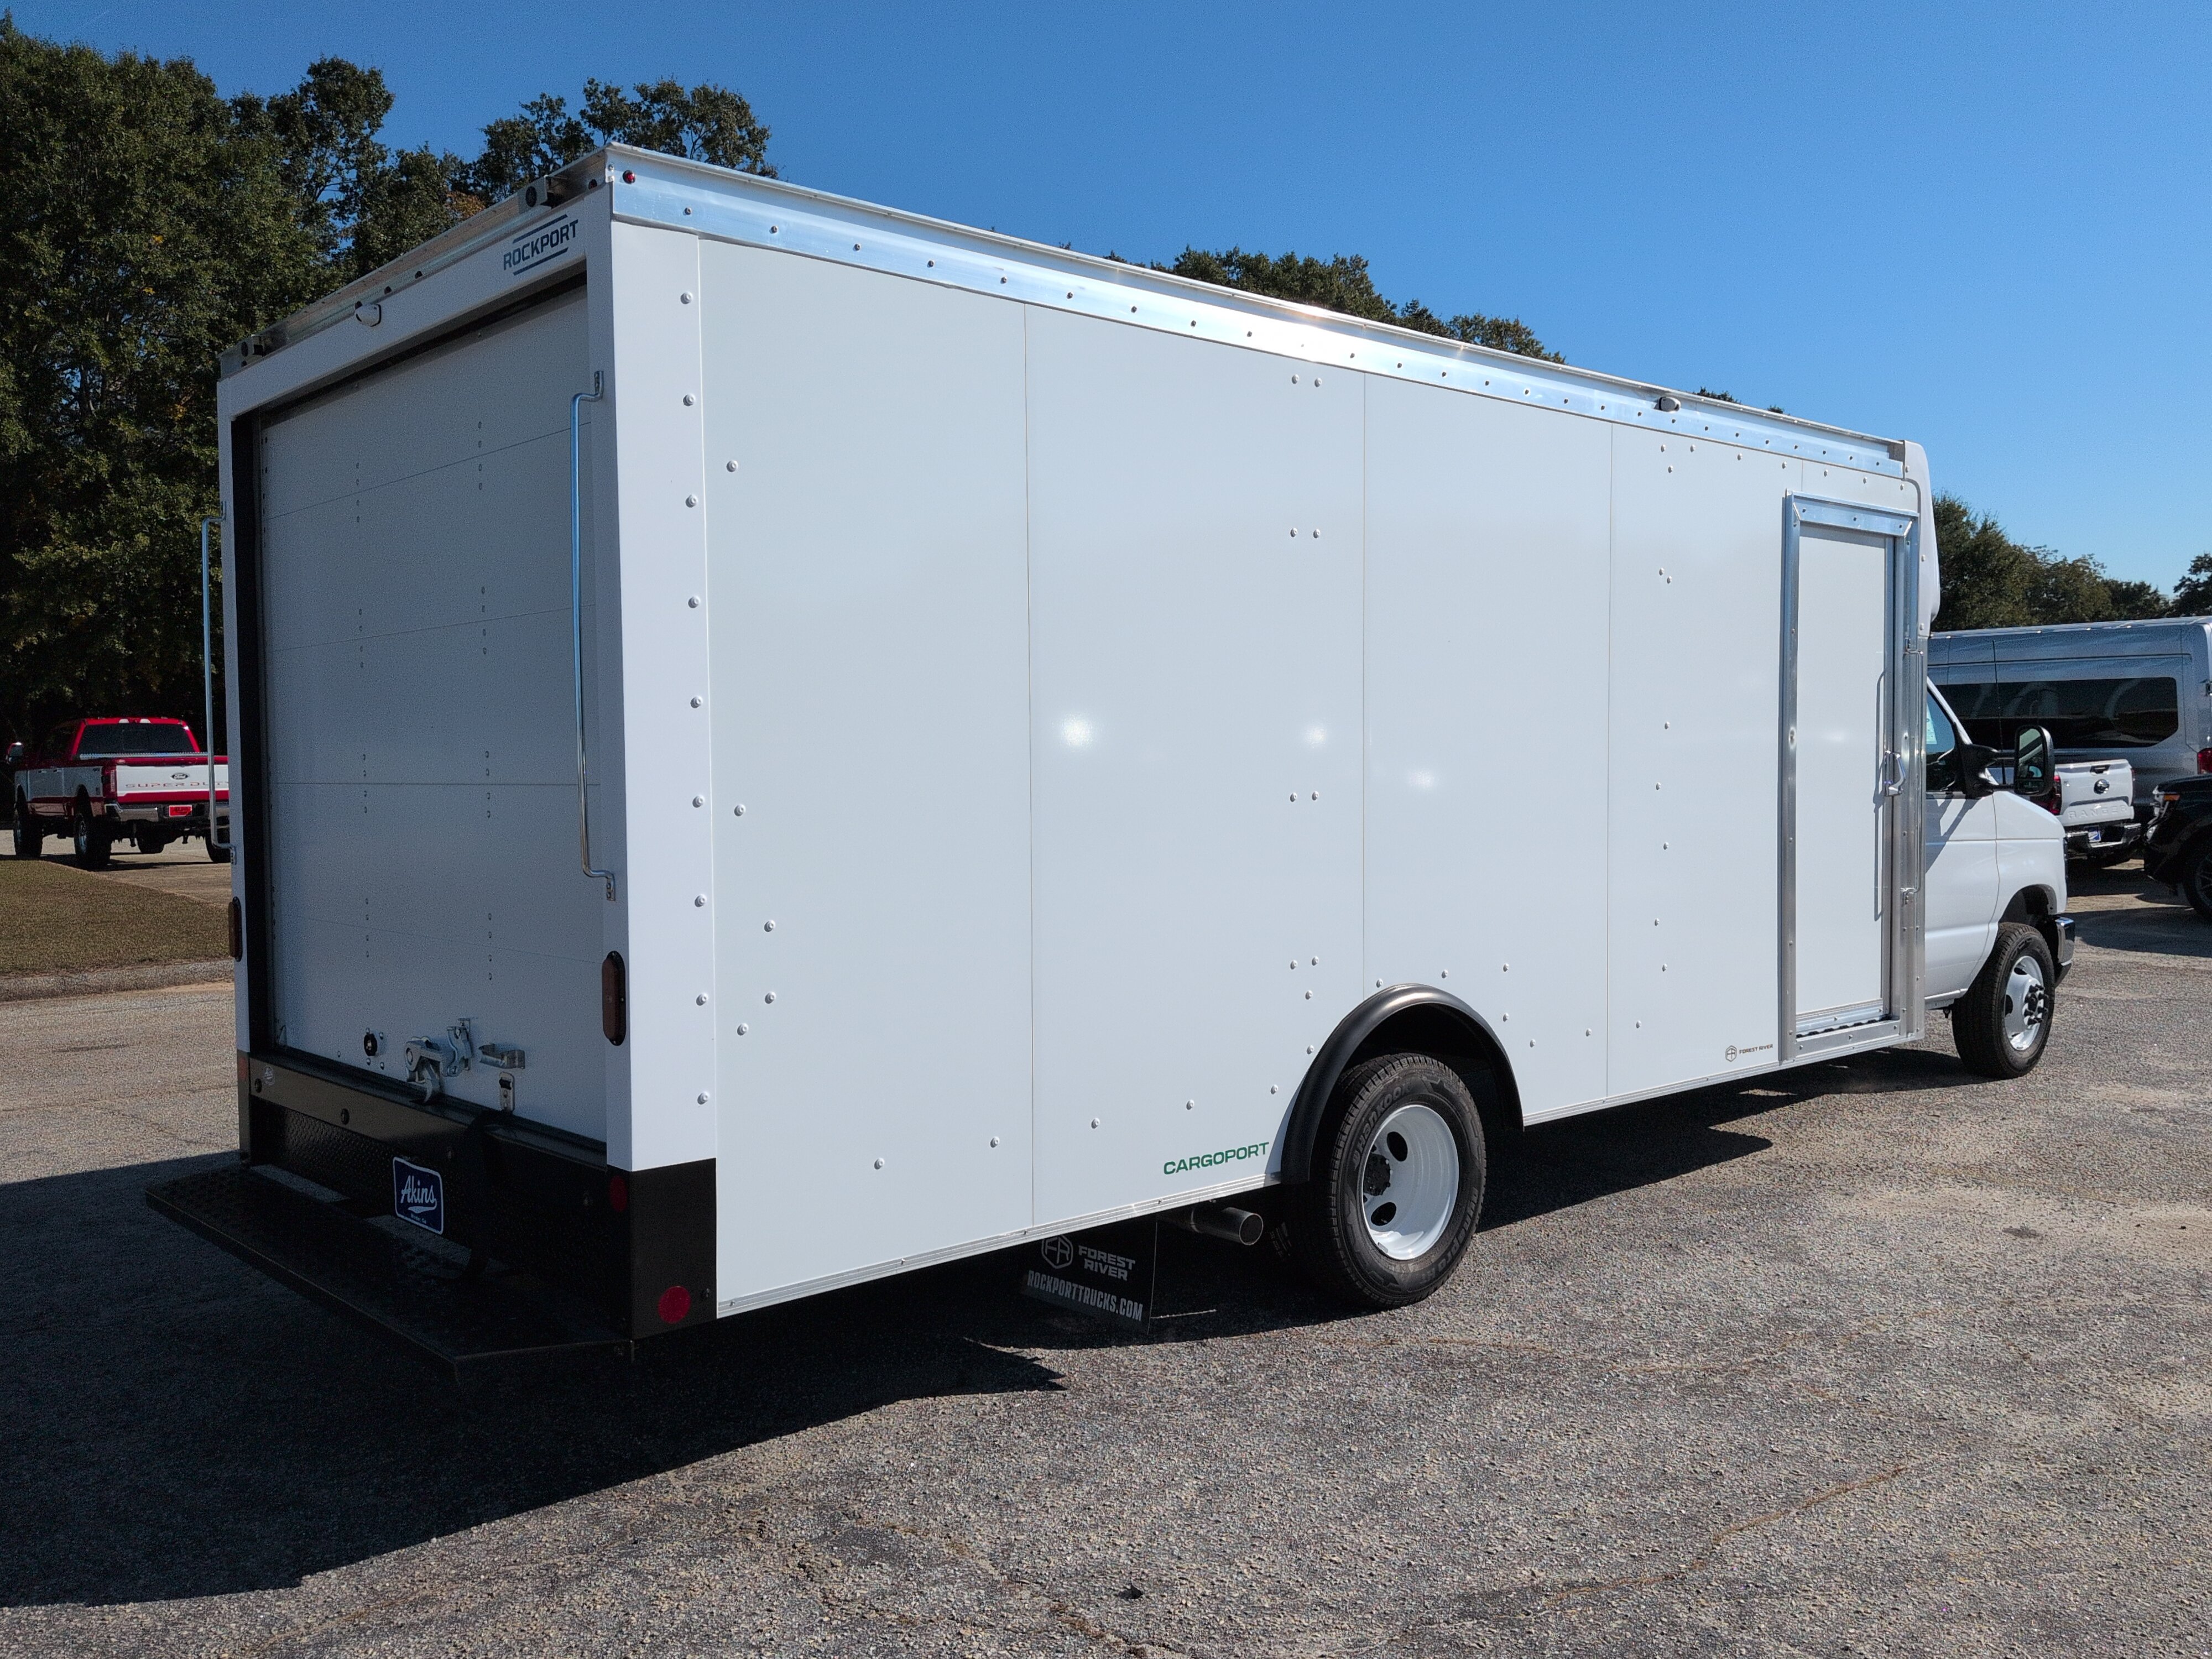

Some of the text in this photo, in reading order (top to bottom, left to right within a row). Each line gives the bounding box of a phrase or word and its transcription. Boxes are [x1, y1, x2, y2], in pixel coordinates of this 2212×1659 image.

[503, 219, 578, 270] ROCKPORT
[2069, 805, 2127, 819] RANGER
[1164, 1142, 1269, 1175] CARGOPORT
[400, 1175, 437, 1203] Akins
[1078, 1245, 1135, 1270] FOREST
[1084, 1259, 1128, 1281] RIVER
[1027, 1270, 1143, 1321] ROCKPORTTRUCKS.COM
